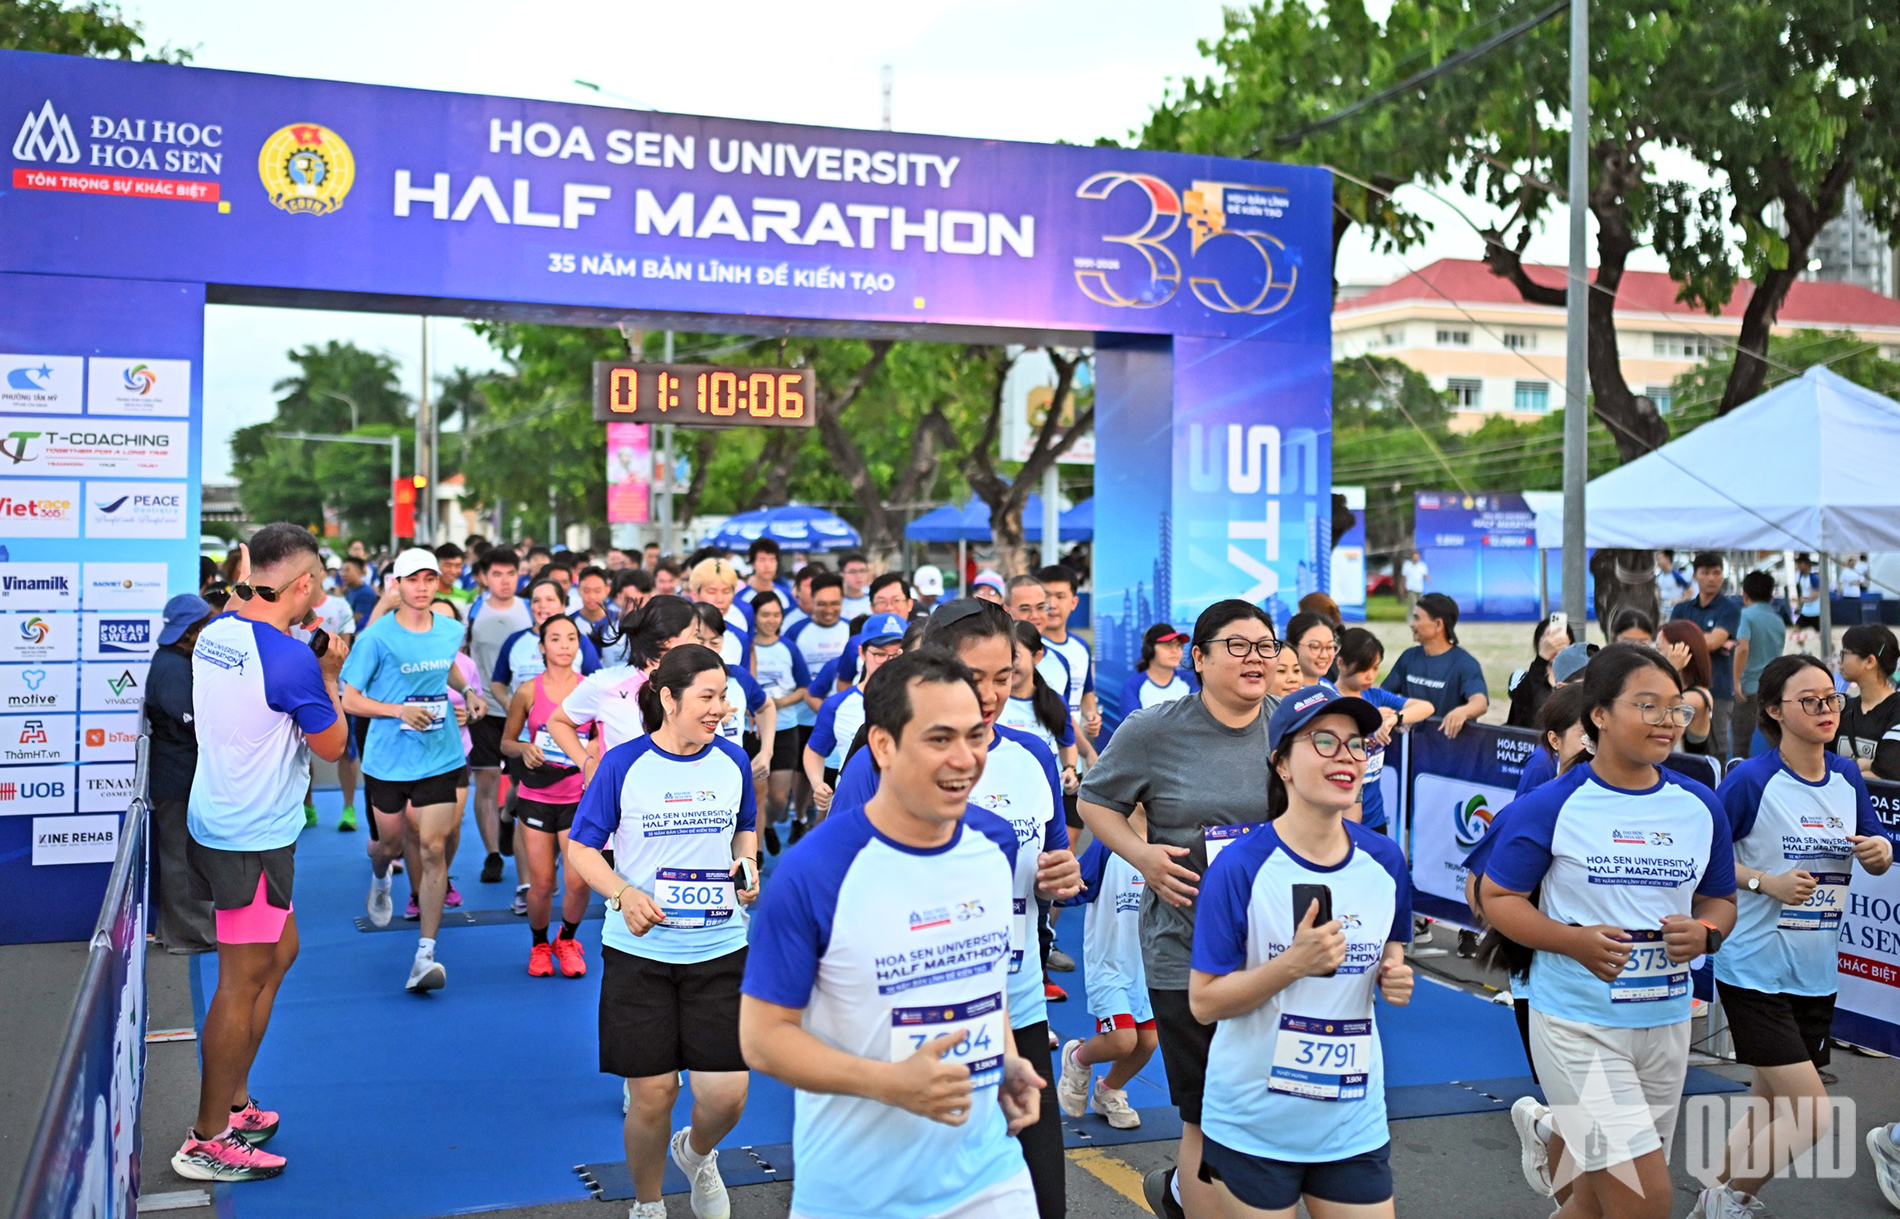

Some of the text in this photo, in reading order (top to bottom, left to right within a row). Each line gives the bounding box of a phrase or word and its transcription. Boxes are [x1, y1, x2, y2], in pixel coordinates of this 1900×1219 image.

[90, 115, 222, 149] ĐẠI HỌC
[90, 145, 222, 175] HOA SEN
[490, 118, 960, 188] HOA SEN UNIVERSITY
[26, 173, 207, 199] TÔN TRỌNG SỰ KHÁC BIỆT
[394, 170, 1035, 259] HALF MARATHON
[548, 253, 894, 295] 35 NĂM BẢN LĨNH ĐỂ KIẾN TẠO
[45, 431, 169, 447] T-COACHING
[38, 499, 71, 509] race
[133, 495, 180, 507] PEACE
[40, 509, 61, 518] 365
[2, 576, 69, 590] Vinamilk
[100, 624, 149, 633] POCARI
[100, 633, 145, 642] SWEAT
[400, 659, 450, 674] GARMIN
[8, 694, 56, 705] motive
[1497, 738, 1535, 753] HOA SEN
[5, 749, 60, 760] ThảmHT.vn
[1497, 750, 1525, 763] HALF
[21, 782, 65, 798] UOB
[1870, 795, 1889, 809] OA
[642, 810, 729, 821] HOA SEN UNIVERSITY
[642, 818, 728, 829] HALF MARATHON
[72, 831, 114, 843] REHAB
[1649, 832, 1674, 846] 35
[1782, 835, 1802, 844] HOA
[1783, 844, 1811, 852] HALF
[1586, 856, 1689, 868] HOA SEN UNIVERSITY
[1587, 865, 1688, 878] HALF MARATHON
[666, 885, 724, 905] 3603
[875, 931, 1006, 969] HOA SEN UNIVERSITY
[1346, 943, 1378, 952] ERSITY
[876, 963, 919, 980] HALF
[924, 945, 1001, 971] MARATHON
[1838, 957, 1897, 982] KHÁC BIỆT
[1295, 1039, 1356, 1068] 3791
